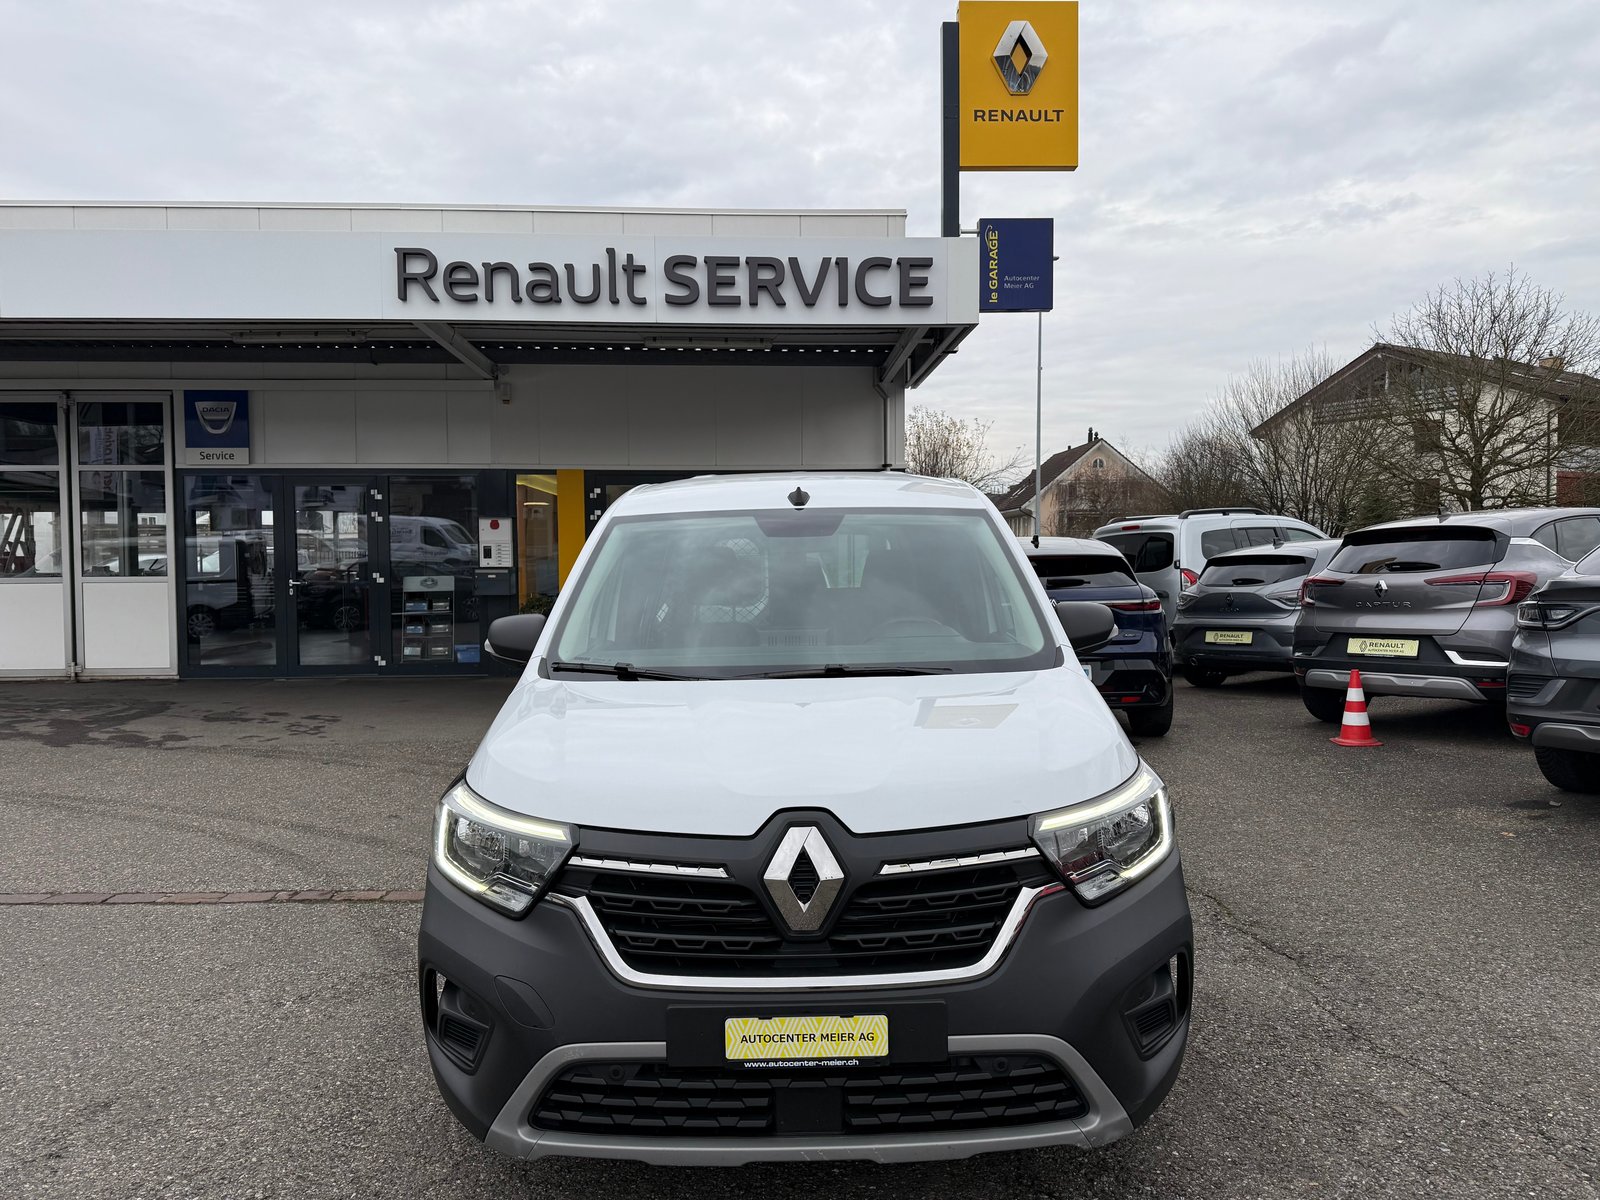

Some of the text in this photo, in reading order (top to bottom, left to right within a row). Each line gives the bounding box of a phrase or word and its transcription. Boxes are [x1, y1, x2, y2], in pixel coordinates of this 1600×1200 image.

[973, 109, 1064, 122] RENAULT
[989, 230, 998, 303] le GARAGE
[394, 247, 934, 307] Renault SERVICE
[199, 451, 235, 460] Service
[740, 1032, 875, 1044] AUTOCENTER MEIER AG
[743, 1058, 859, 1067] www.autocenter-meier.ch
